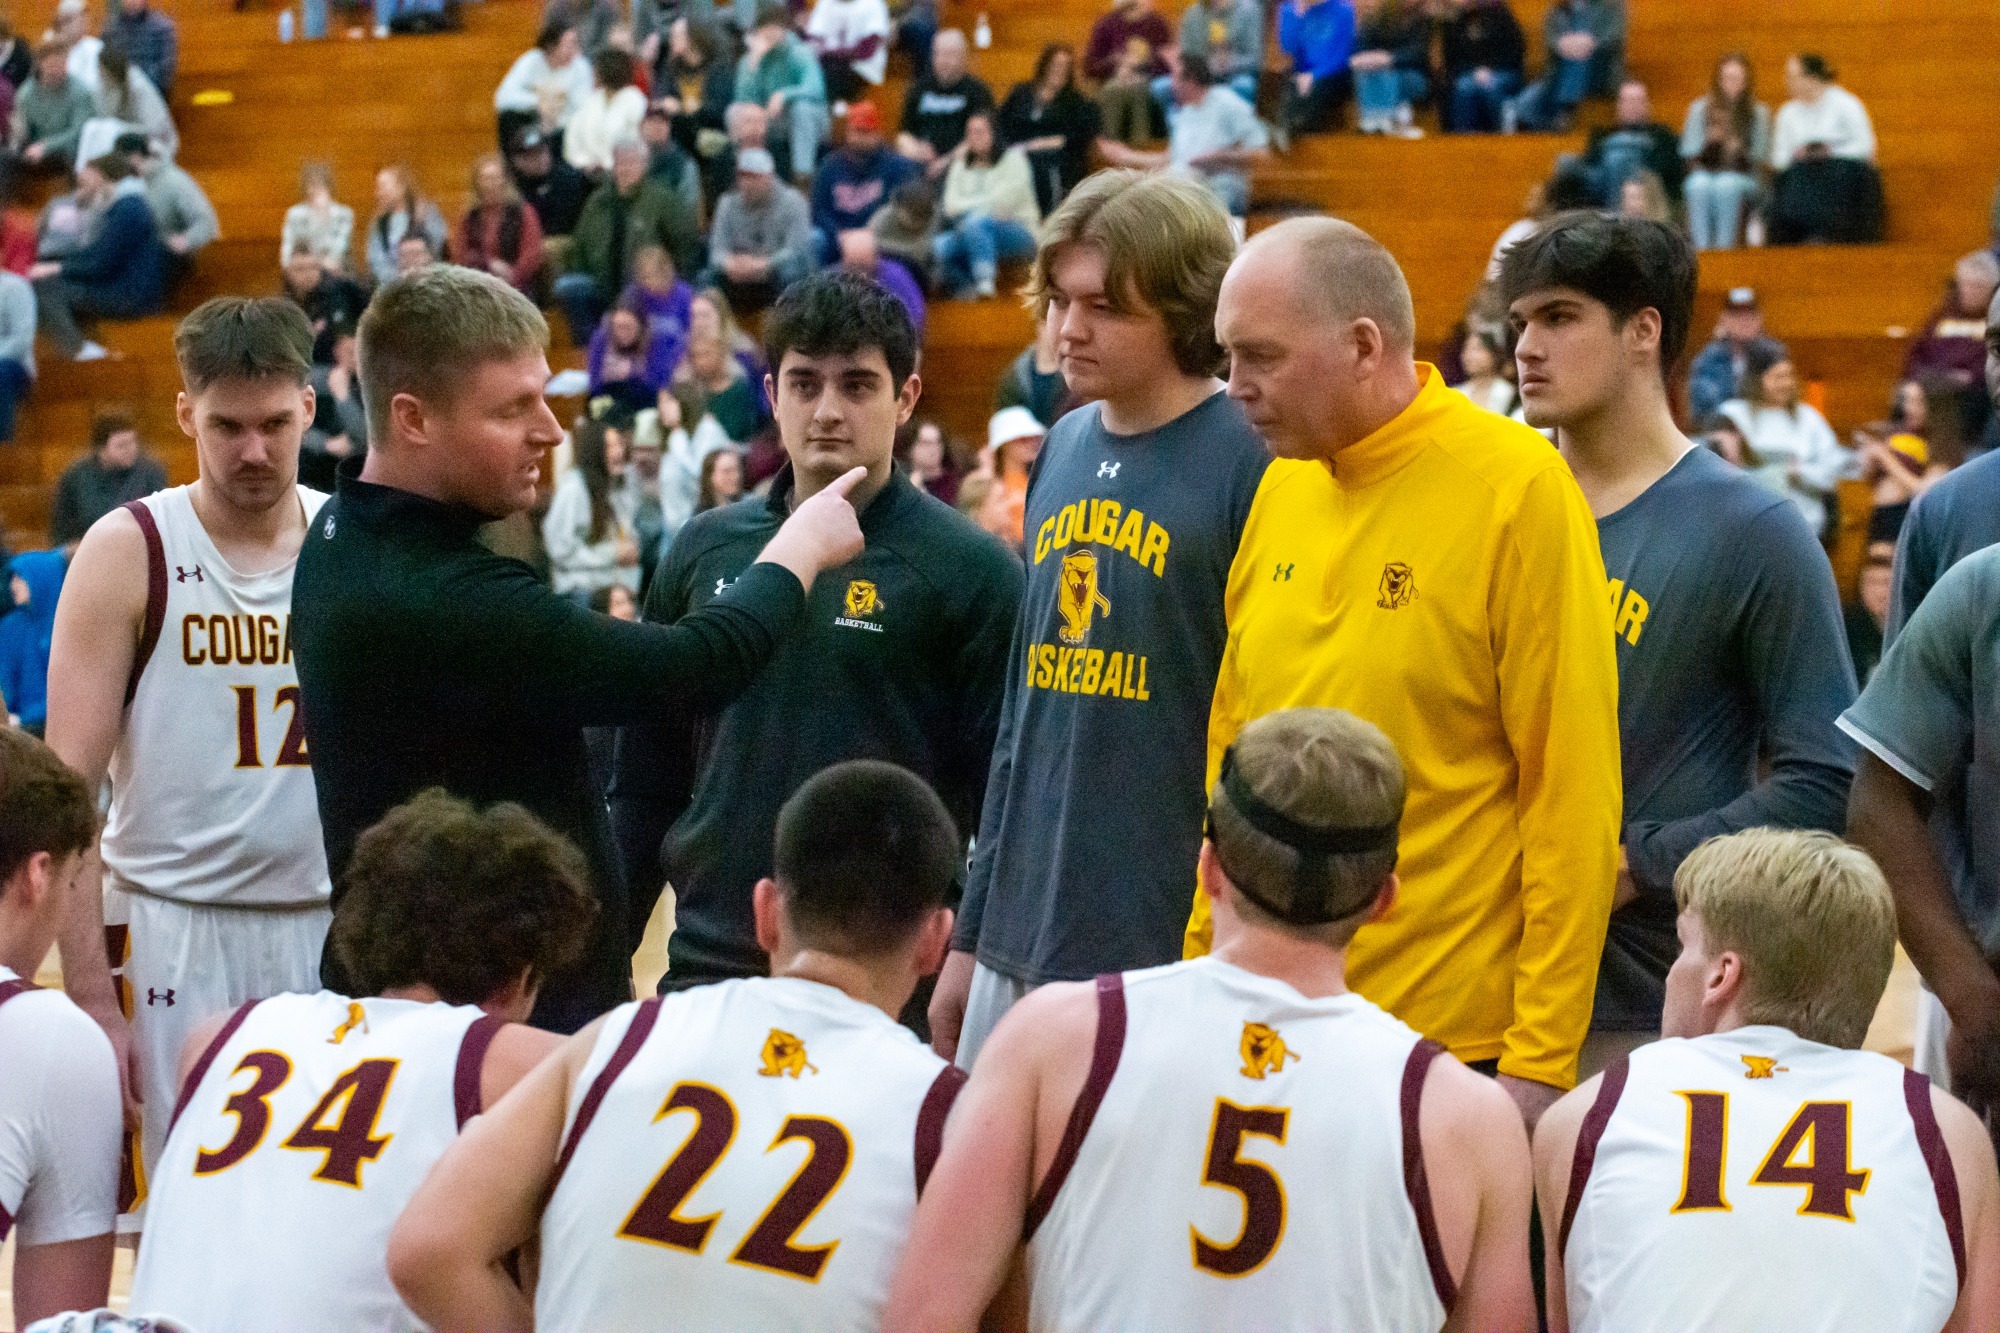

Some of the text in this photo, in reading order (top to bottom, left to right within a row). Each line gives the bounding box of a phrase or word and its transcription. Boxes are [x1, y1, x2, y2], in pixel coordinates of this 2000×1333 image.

[1034, 498, 1170, 578] COUGAR
[834, 617, 884, 632] BASKETBALL
[229, 684, 312, 769] 12
[193, 1048, 402, 1190] 34
[615, 1079, 855, 1284] 22
[1670, 1089, 1872, 1223] 14
[1188, 1095, 1292, 1279] 5
